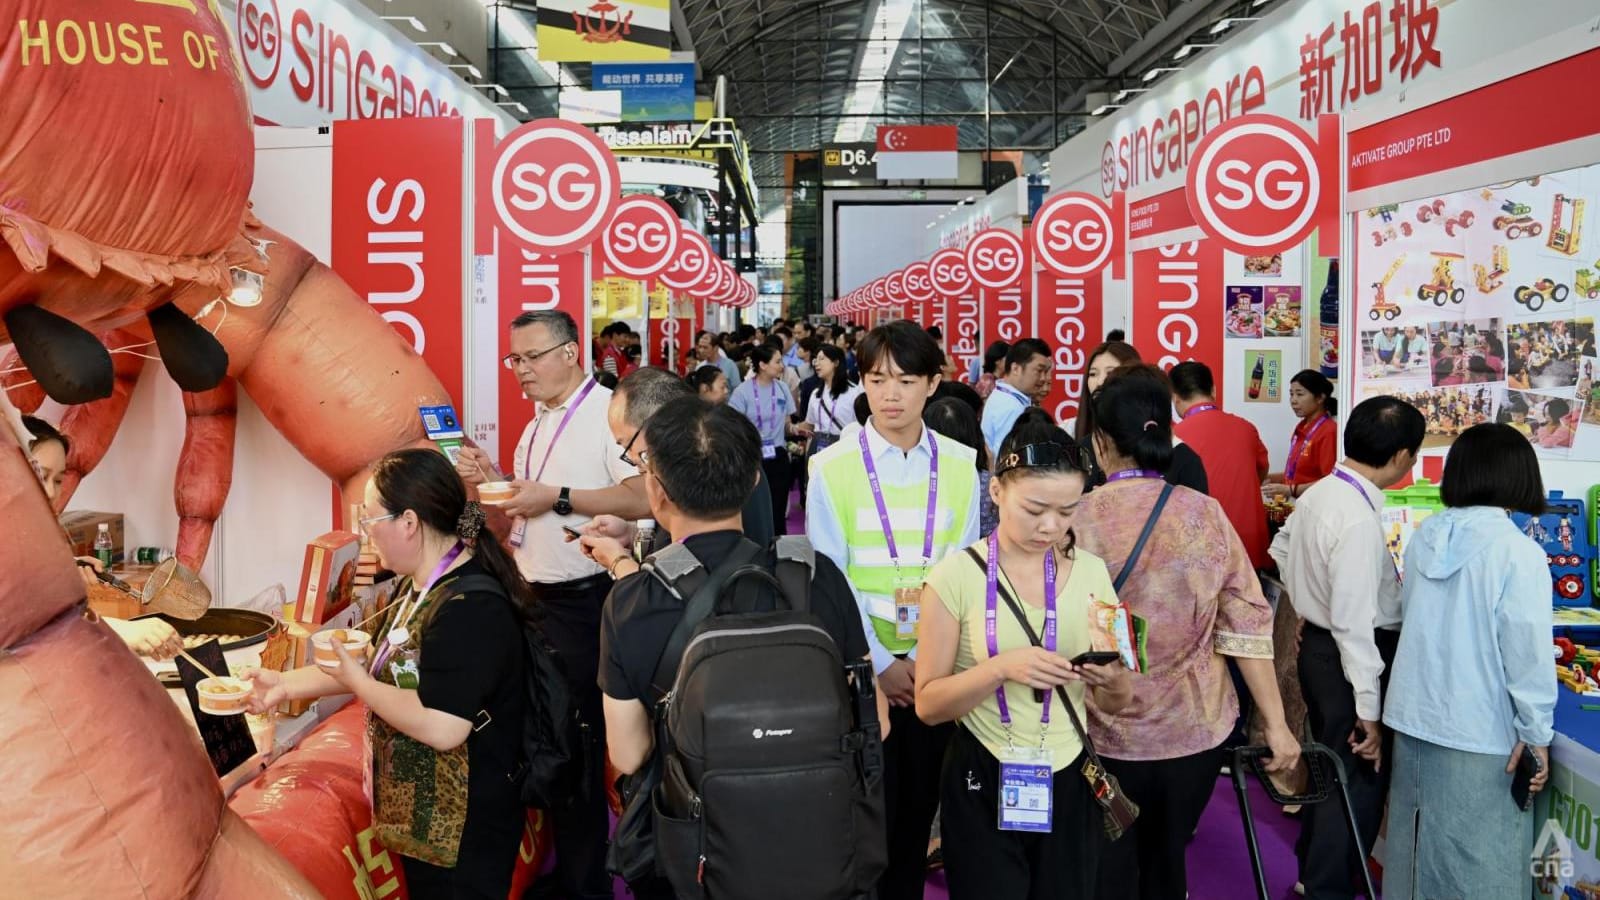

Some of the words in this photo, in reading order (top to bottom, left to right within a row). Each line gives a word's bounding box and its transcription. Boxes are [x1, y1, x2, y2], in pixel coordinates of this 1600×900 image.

[18, 18, 169, 66] HOUSE
[183, 30, 219, 71] OF
[244, 2, 276, 58] SG
[1299, 0, 1442, 121] 新加坡
[1351, 145, 1386, 169] AKTIVATE
[1386, 137, 1415, 159] GROUP
[1416, 131, 1433, 151] PTE
[1434, 127, 1451, 145] LTD
[510, 162, 596, 211] SG
[1214, 159, 1304, 210] SG
[613, 221, 668, 254] SG
[1047, 219, 1103, 251] SG
[936, 264, 968, 283] SG
[976, 248, 1017, 271] SG
